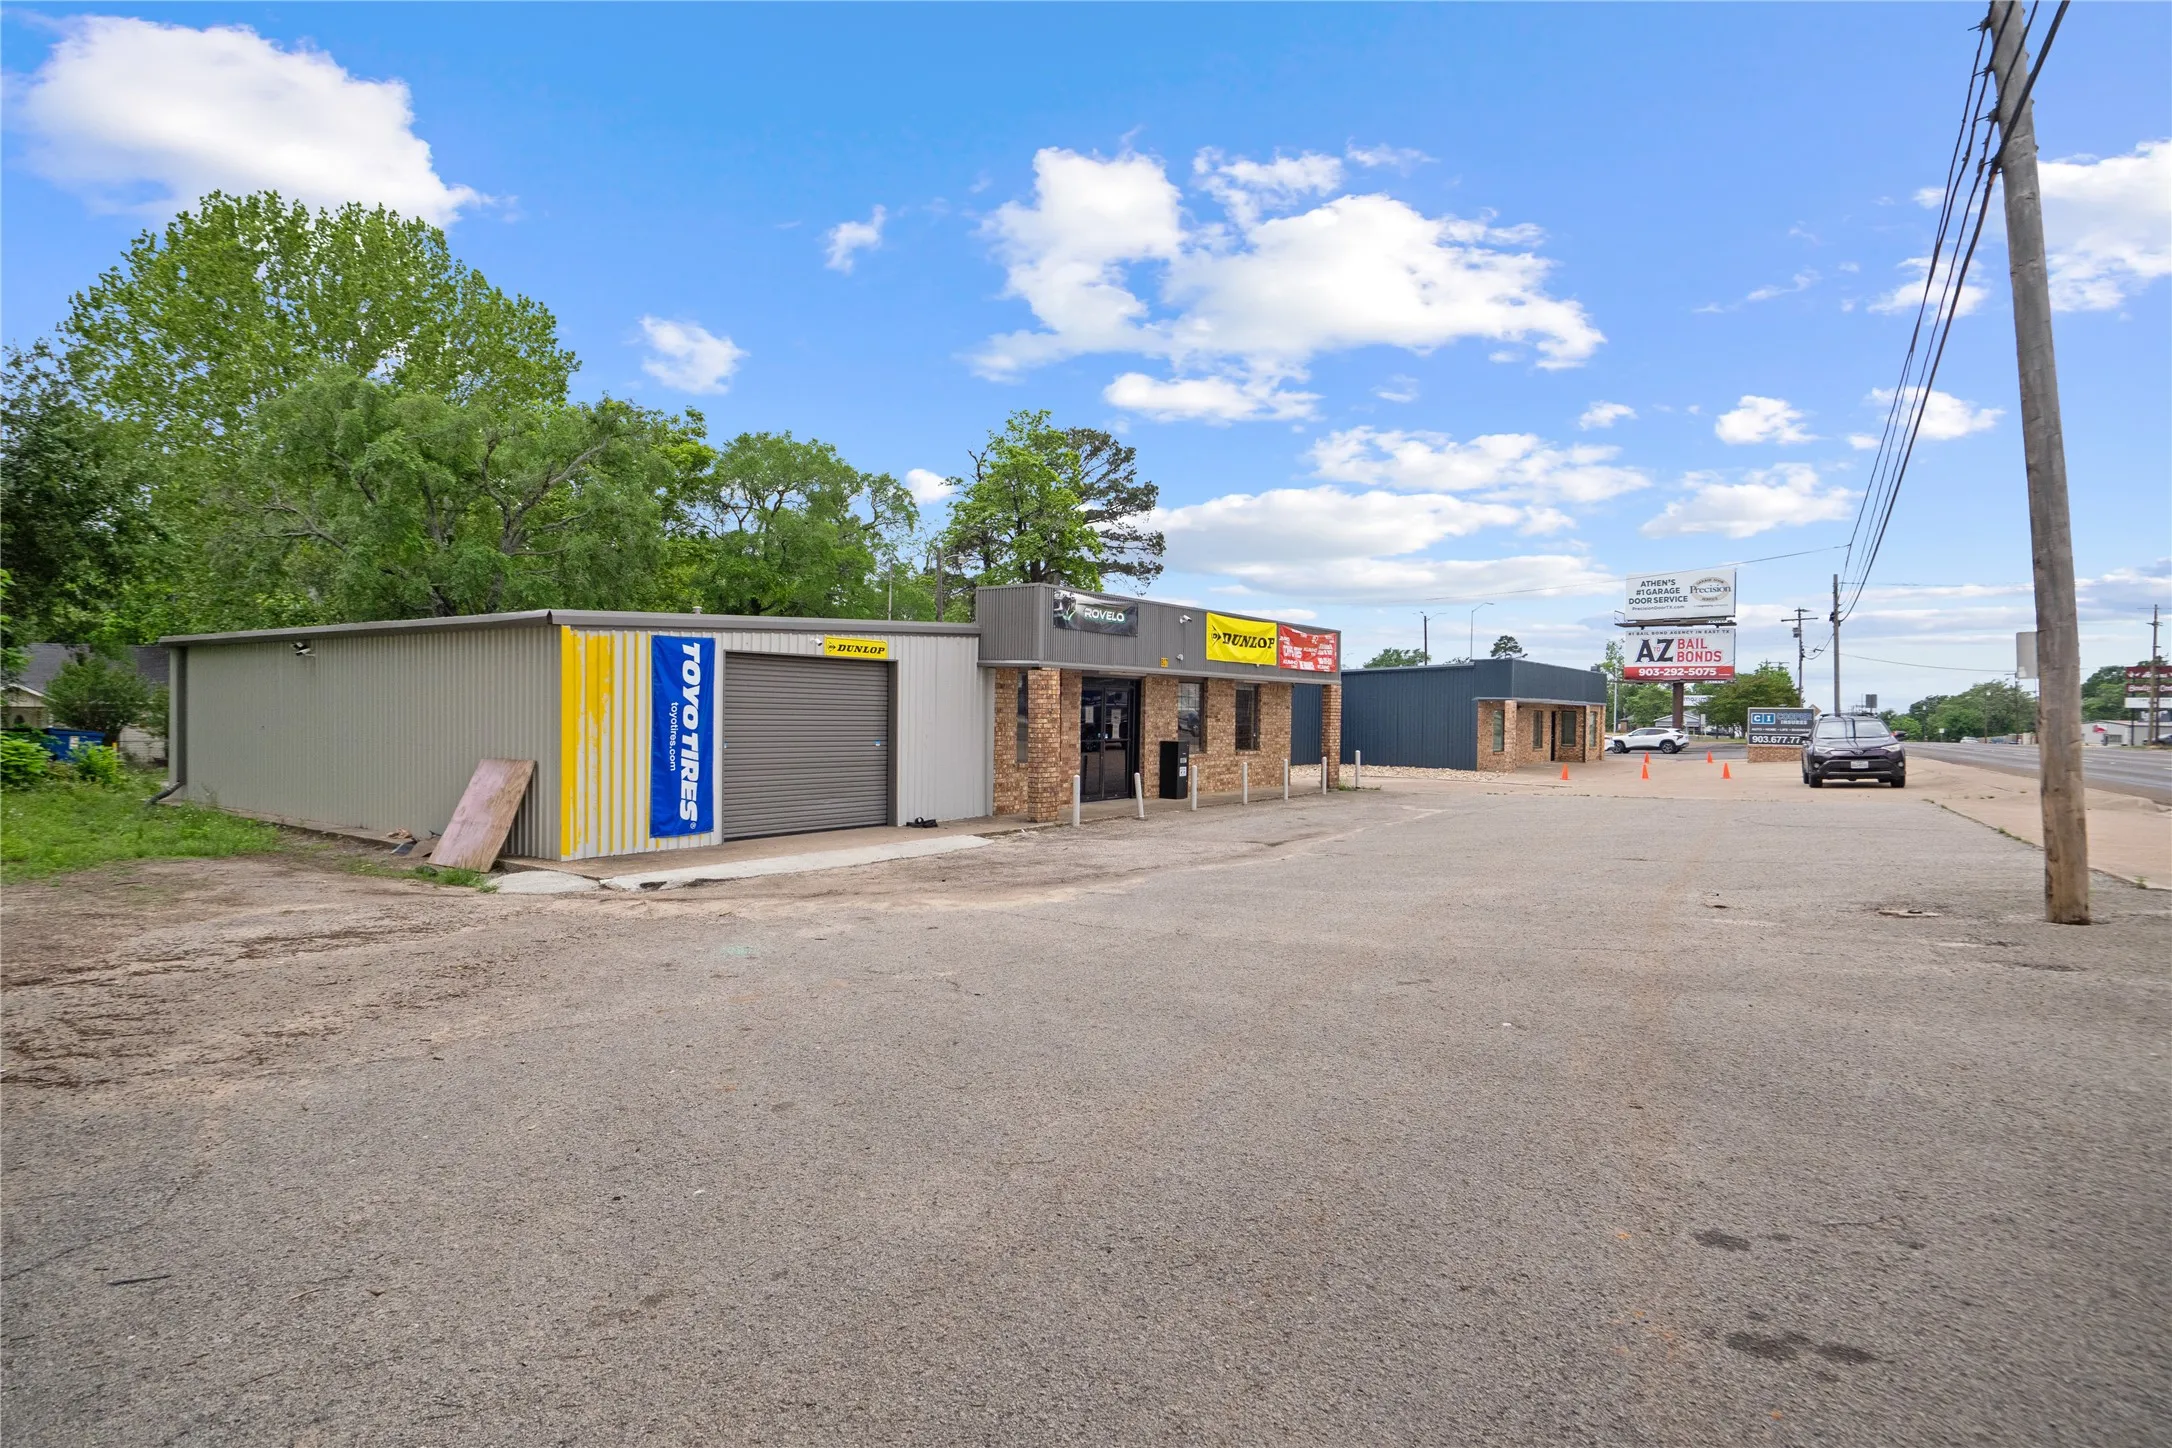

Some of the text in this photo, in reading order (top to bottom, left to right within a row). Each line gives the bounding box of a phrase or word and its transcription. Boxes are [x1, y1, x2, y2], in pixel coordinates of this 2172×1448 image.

[1640, 578, 1676, 588] ATHEN'S
[1689, 583, 1732, 594] Precision
[1645, 587, 1681, 596] GARAGE
[1628, 595, 1689, 605] DOOR SERVICE
[1084, 607, 1125, 622] ROVELO
[1222, 632, 1275, 649] DUNLOP
[1676, 638, 1708, 650] BAIL
[837, 644, 885, 655] DUNLOP
[1635, 638, 1656, 662] A
[1655, 638, 1675, 662] Z
[1676, 650, 1722, 662] BONDS
[1638, 667, 1717, 677] 903-292-5075
[669, 701, 679, 772] toyotires.com
[679, 642, 701, 822] TOYO TIRES
[1752, 735, 1804, 744] 903.677.77
